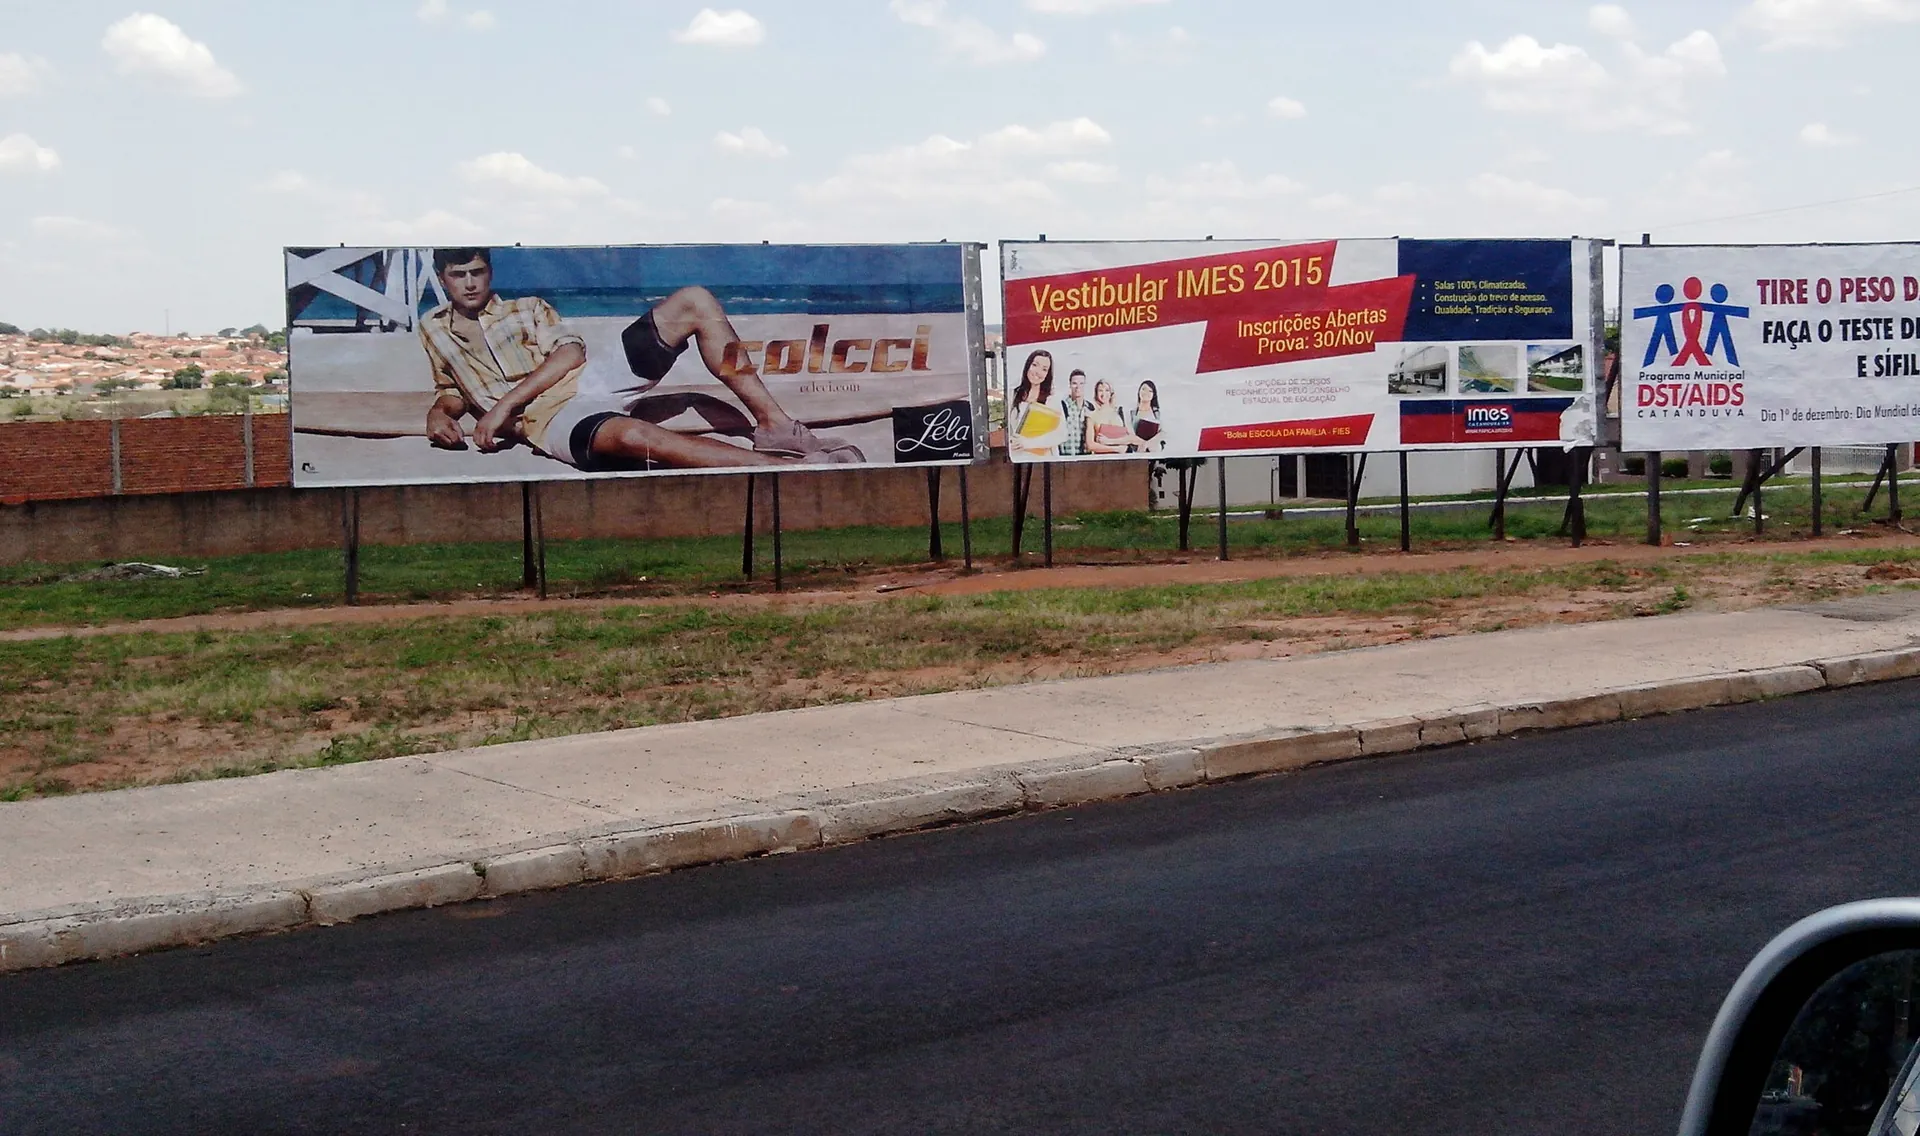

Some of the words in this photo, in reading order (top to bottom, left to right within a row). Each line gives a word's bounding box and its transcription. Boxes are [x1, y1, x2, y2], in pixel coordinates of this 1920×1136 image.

[1030, 276, 1168, 313] Vestibular
[1176, 264, 1245, 298] IMES
[1254, 256, 1322, 291] 2015
[1434, 281, 1454, 290] Salas
[1457, 280, 1477, 290] 100%
[1756, 278, 1808, 305] TIRE
[1816, 277, 1832, 304] O
[1840, 276, 1895, 303] PESO
[1903, 276, 1920, 301] D
[1434, 293, 1477, 303] Construção
[1478, 293, 1488, 301] do
[1489, 293, 1508, 301] trevo
[1509, 293, 1519, 301] de
[1040, 305, 1157, 333] #vemproIMES
[1475, 305, 1507, 315] Tradição
[1238, 313, 1320, 338] Inscrições
[1325, 309, 1387, 328] Abertas
[1762, 320, 1812, 350] FAÇA
[1818, 318, 1832, 342] O
[1839, 317, 1894, 342] TESTE
[719, 324, 933, 376] colcci
[1258, 337, 1309, 354] Prova:
[1313, 329, 1375, 349] 30/Nov
[1639, 371, 1690, 383] Programa
[1694, 370, 1745, 382] Municipal
[1857, 355, 1867, 378] E
[1300, 378, 1331, 386] CURSOS
[1283, 396, 1294, 404] DE
[1637, 383, 1745, 408] DST/AIDS
[1638, 409, 1744, 418] CATANDUVA
[1761, 409, 1777, 422] Dia
[1792, 409, 1803, 421] de
[1806, 407, 1853, 421] dezembro:
[1857, 406, 1871, 419] Dia
[1874, 404, 1909, 418] Mundial
[896, 408, 970, 452] Lela
[1249, 429, 1282, 438] ESCOLA
[1283, 428, 1295, 437] DA
[1332, 427, 1351, 436] FIES
